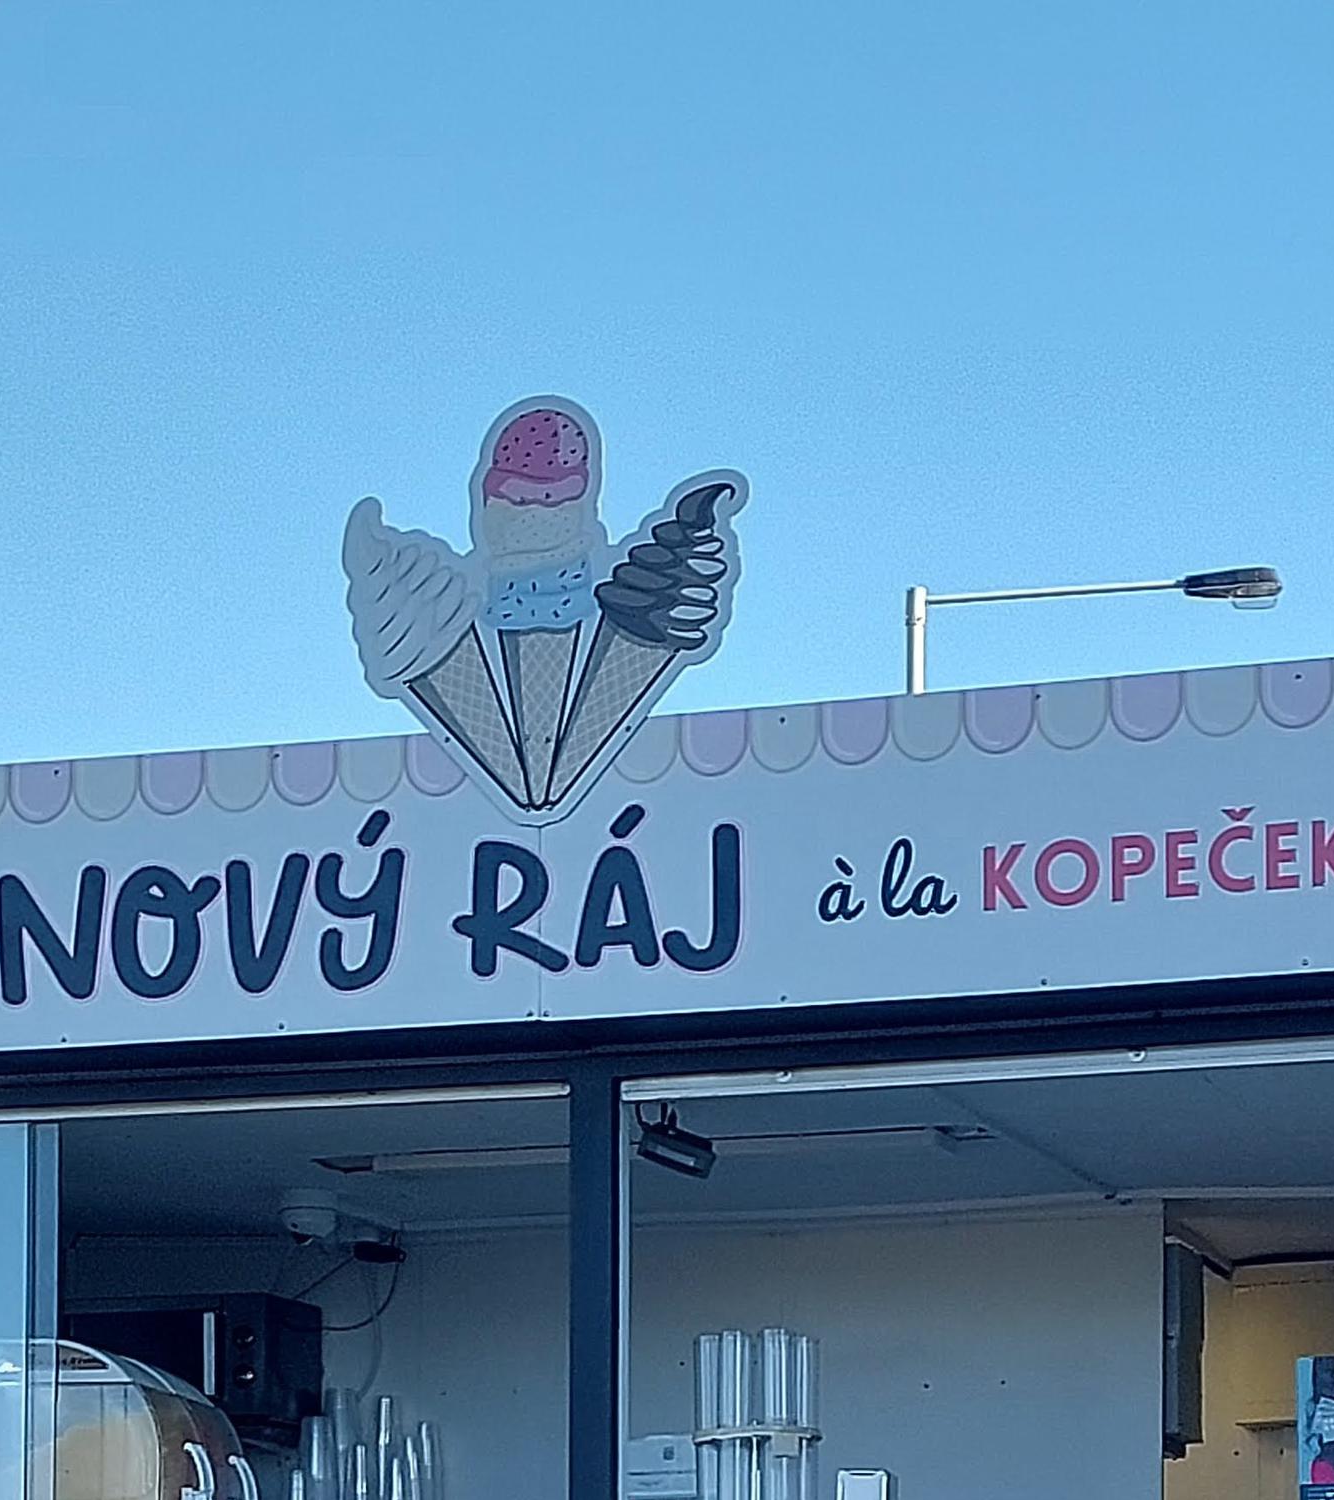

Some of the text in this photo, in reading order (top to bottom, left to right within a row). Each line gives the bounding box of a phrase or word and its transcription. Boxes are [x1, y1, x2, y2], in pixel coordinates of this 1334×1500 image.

[452, 804, 741, 977] RÁJ
[818, 856, 865, 922] à
[881, 837, 958, 918] la
